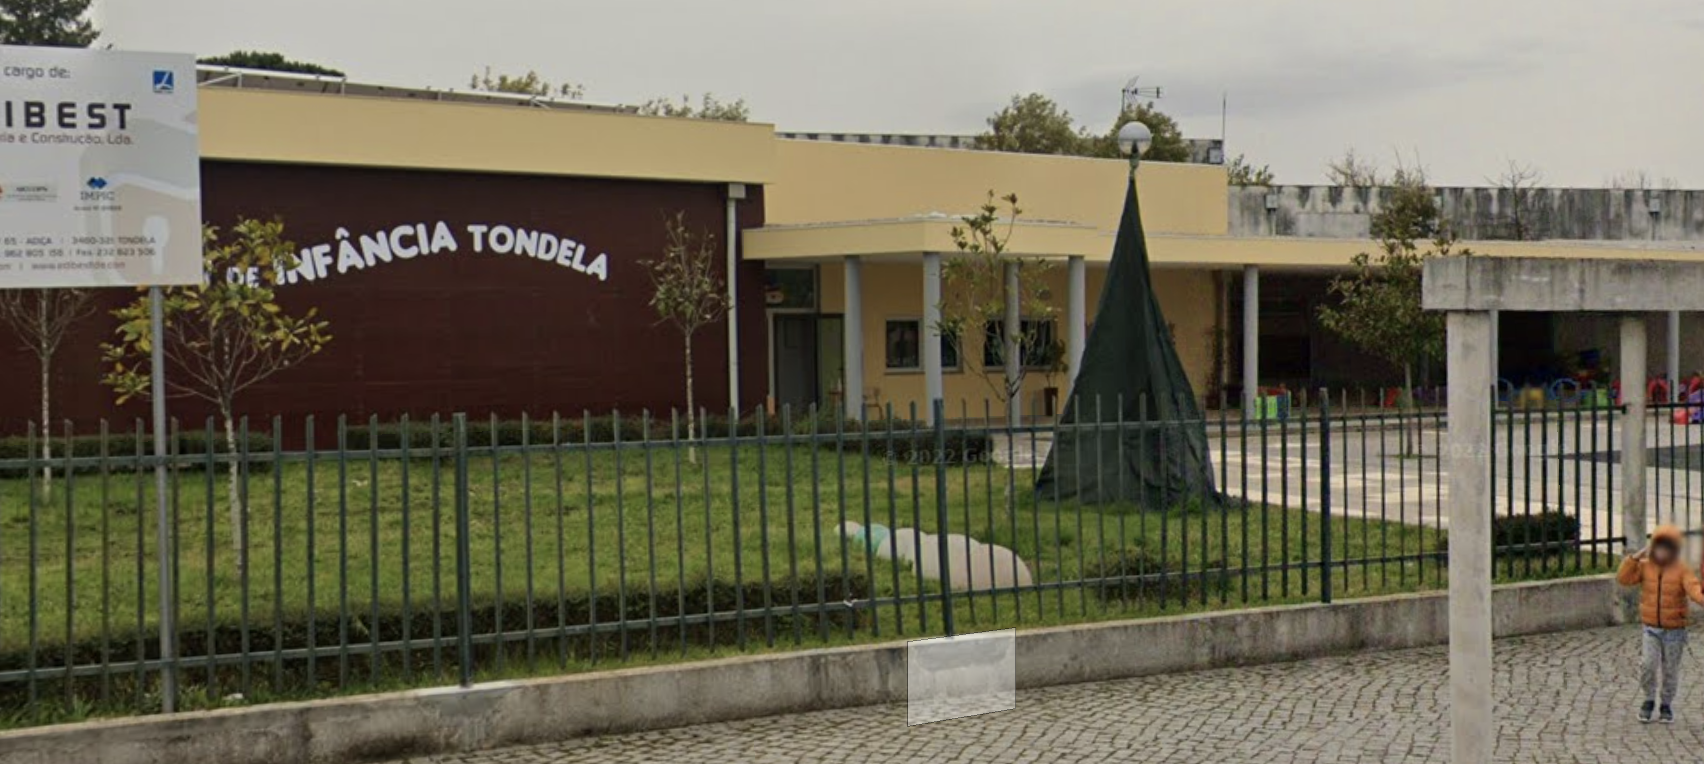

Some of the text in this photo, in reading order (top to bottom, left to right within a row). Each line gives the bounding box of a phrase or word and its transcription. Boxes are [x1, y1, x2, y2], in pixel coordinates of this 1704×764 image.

[3, 65, 71, 80] cargo de:
[18, 135, 27, 144] e
[118, 236, 156, 245] TONDELA
[272, 220, 458, 286] INFÂNCIA
[467, 224, 608, 281] TONDELA
